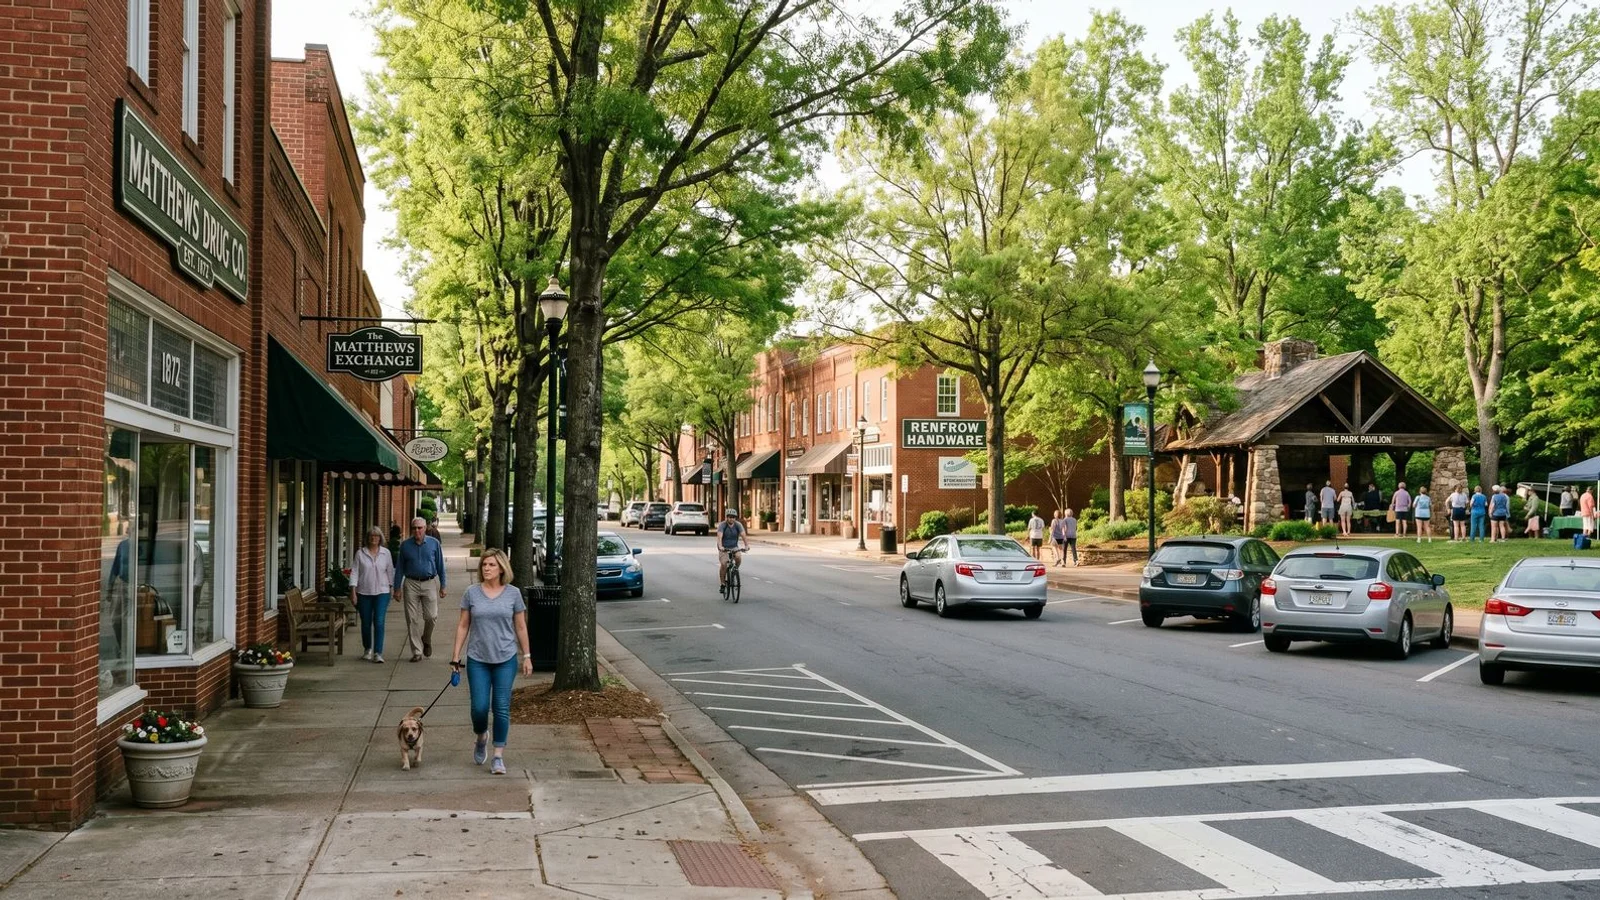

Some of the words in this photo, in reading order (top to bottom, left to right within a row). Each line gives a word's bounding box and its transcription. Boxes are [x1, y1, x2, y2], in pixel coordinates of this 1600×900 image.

[129, 133, 200, 241] MATTHEWS
[202, 208, 229, 269] DRUG
[231, 239, 246, 283] CO.
[183, 246, 196, 270] EST.
[366, 332, 383, 340] The
[334, 341, 415, 353] MATTHEWS
[335, 354, 414, 366] EXCHANGE
[162, 352, 180, 388] 1872
[911, 422, 979, 433] RENFROW
[907, 434, 984, 445] HANDWARE
[1325, 435, 1339, 444] THE
[1340, 435, 1359, 444] PARK
[1360, 435, 1392, 444] PAVILION
